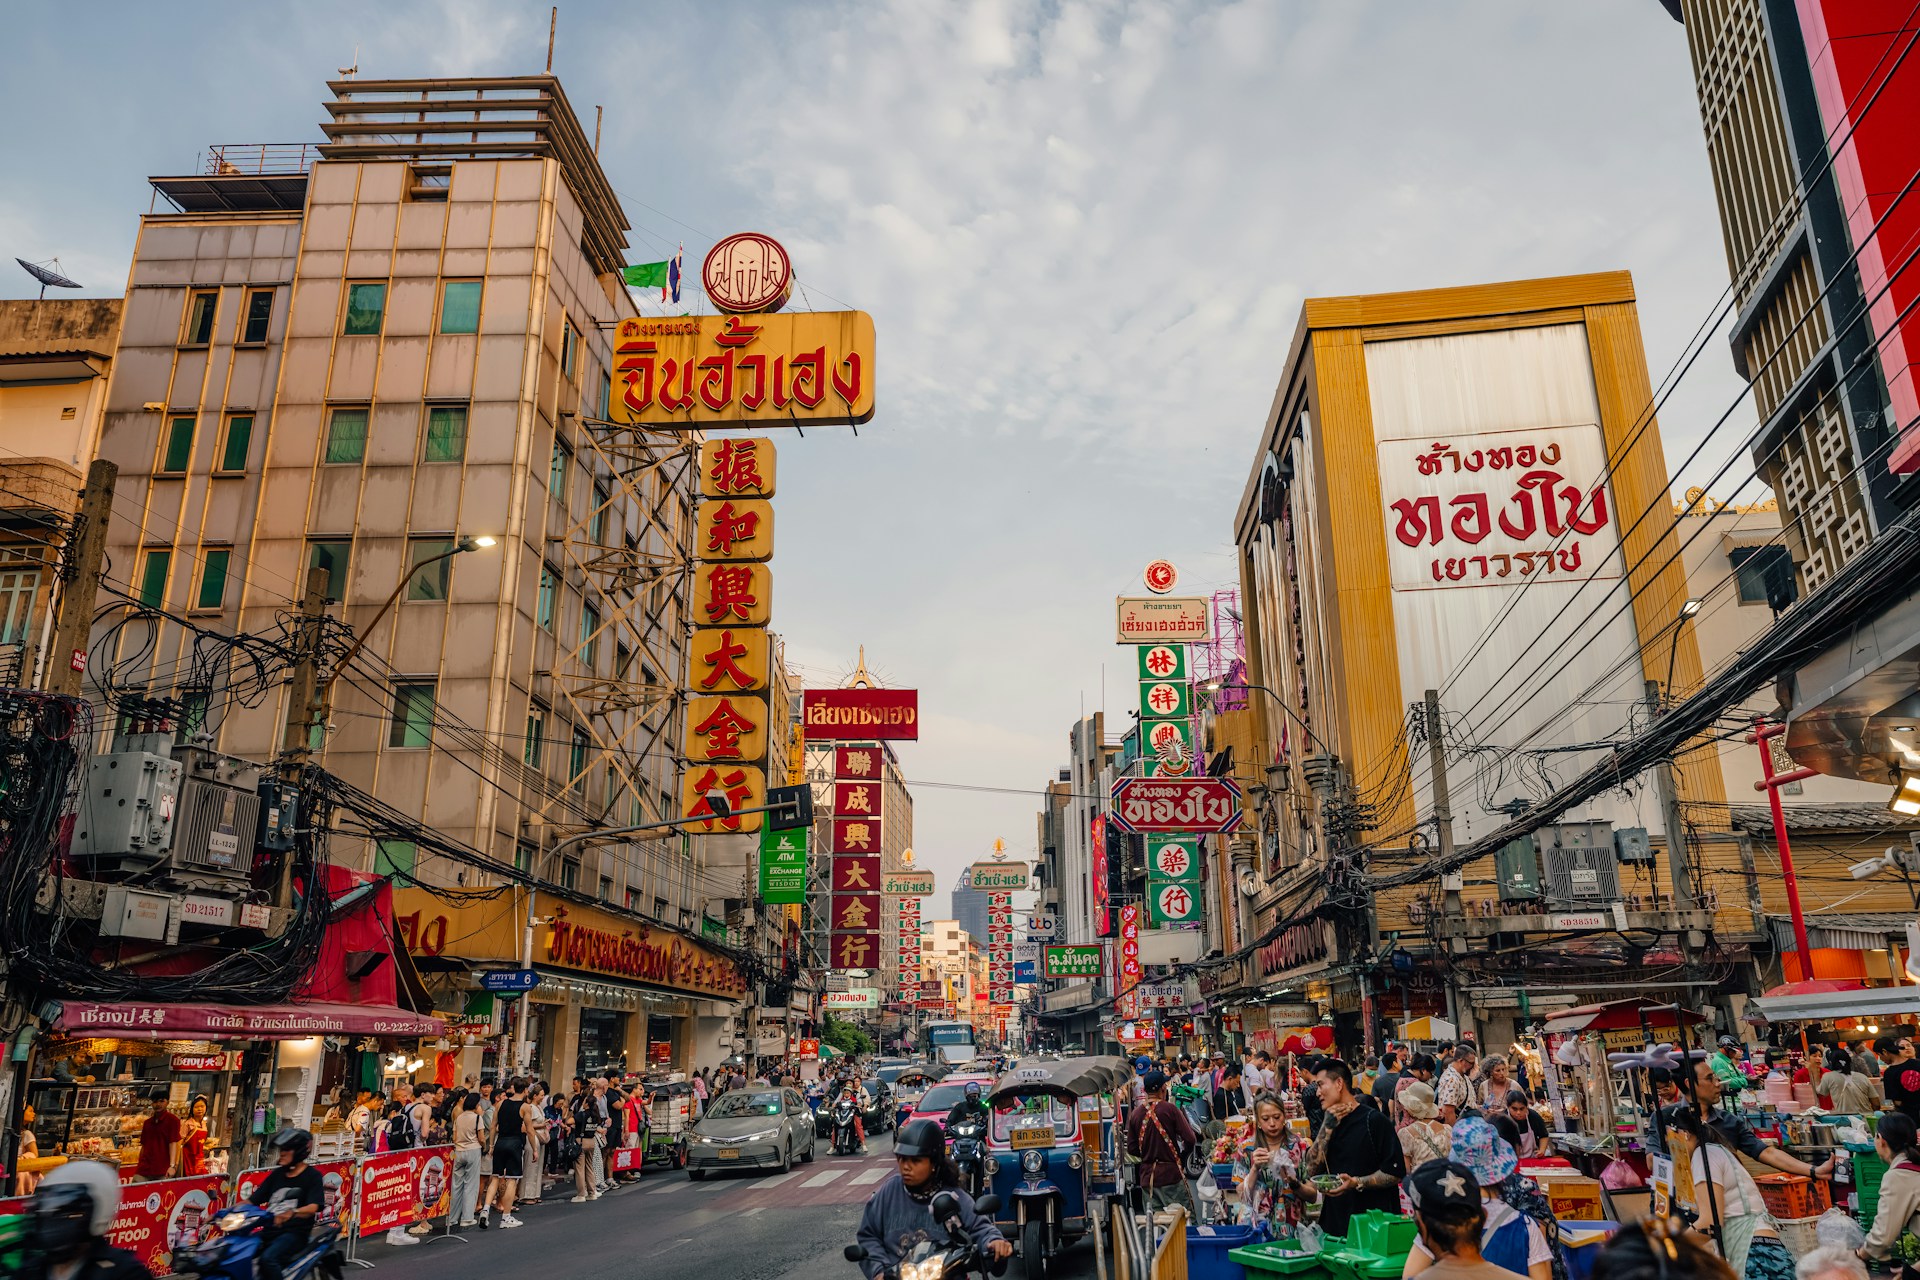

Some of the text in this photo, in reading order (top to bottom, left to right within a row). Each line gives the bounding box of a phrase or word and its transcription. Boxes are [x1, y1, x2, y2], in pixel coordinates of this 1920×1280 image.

[1416, 442, 1561, 475] ห้างทอง
[1390, 471, 1609, 547] ทองใบ
[1432, 542, 1581, 582] เยาวราช
[1130, 783, 1182, 798] ห้างทอง
[1124, 786, 1230, 823] ทองใบ
[777, 853, 795, 861] ATM
[838, 751, 872, 967] 聯成興大金行
[1029, 917, 1052, 930] ttb
[524, 974, 531, 984] 6
[139, 1009, 165, 1024] 長富
[207, 1015, 244, 1027] เกาลัด
[1031, 1130, 1051, 1140] 3533
[377, 1174, 406, 1189] YAOWARAJ
[367, 1187, 394, 1203] STREET
[394, 1182, 412, 1195] FOO
[117, 1227, 150, 1244] FOOD
